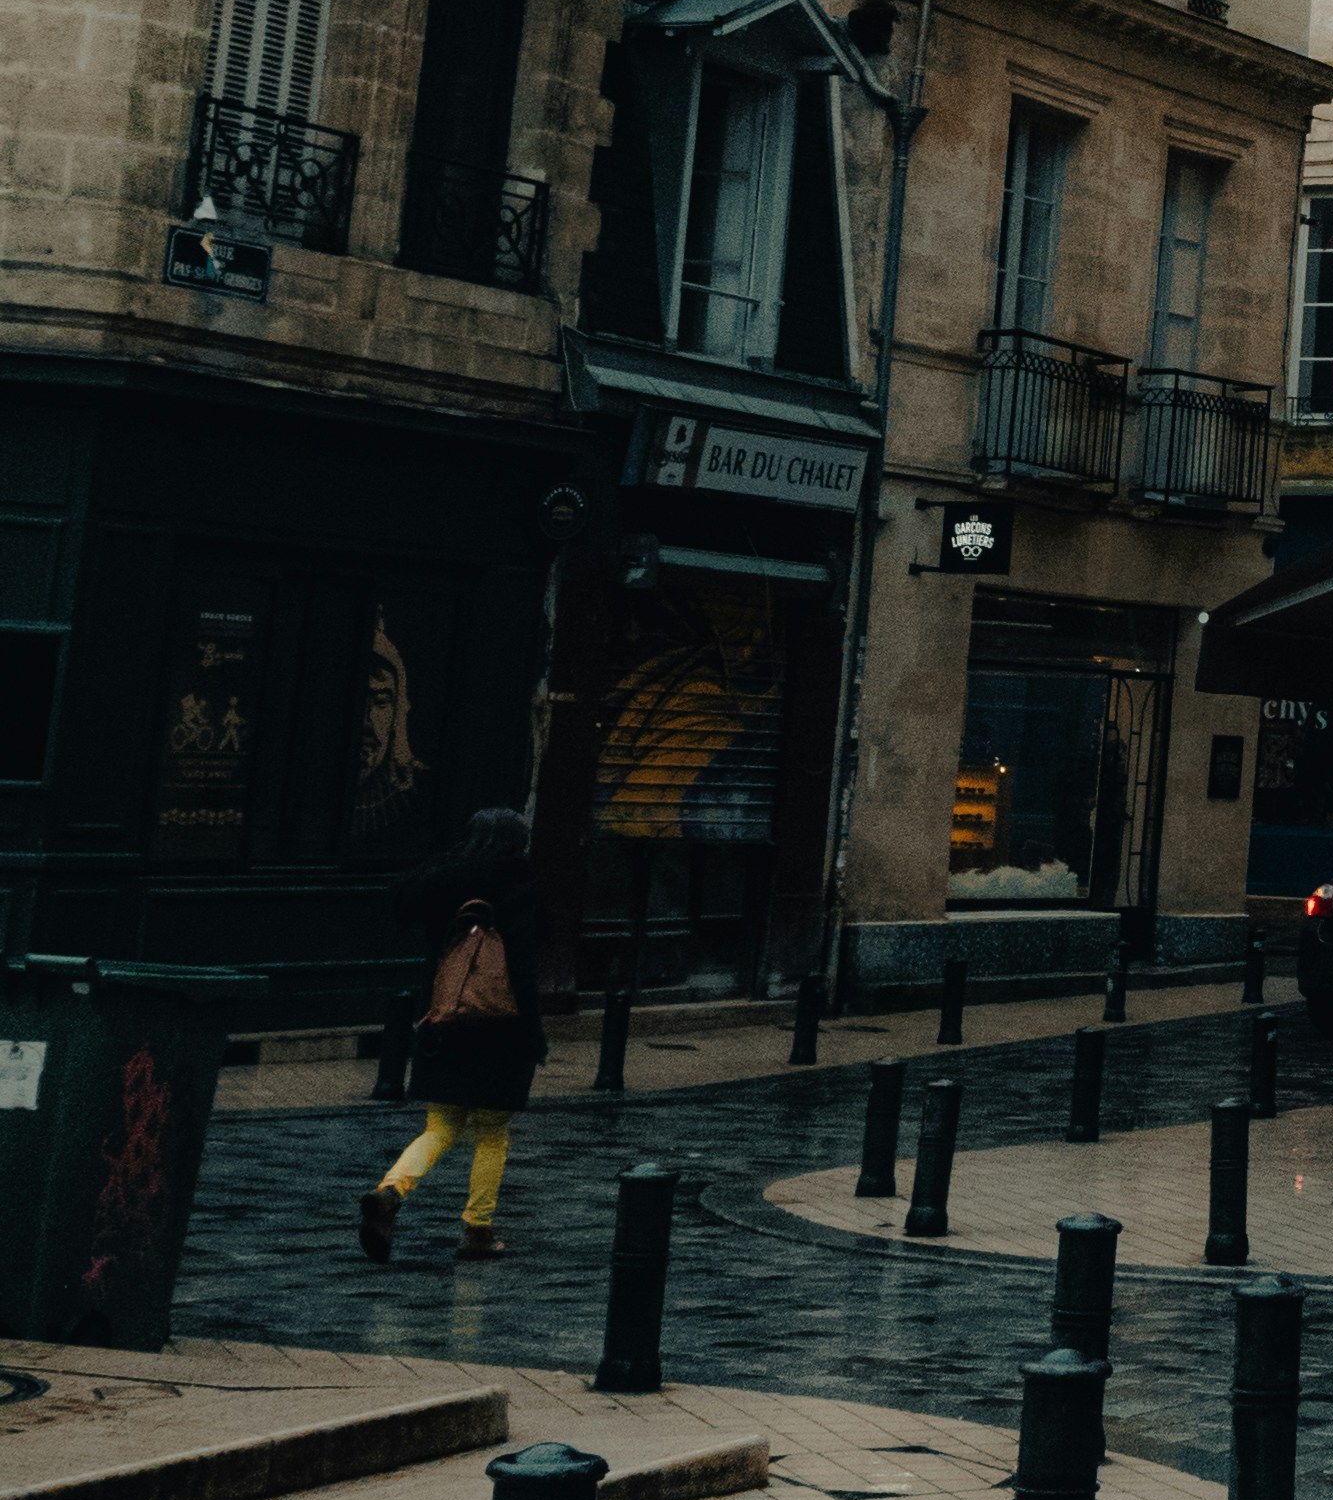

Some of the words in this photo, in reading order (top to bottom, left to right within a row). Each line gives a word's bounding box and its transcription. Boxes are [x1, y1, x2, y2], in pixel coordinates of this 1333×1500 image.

[707, 444, 747, 477] BAR
[750, 451, 784, 482] DU
[786, 456, 859, 492] CHALET
